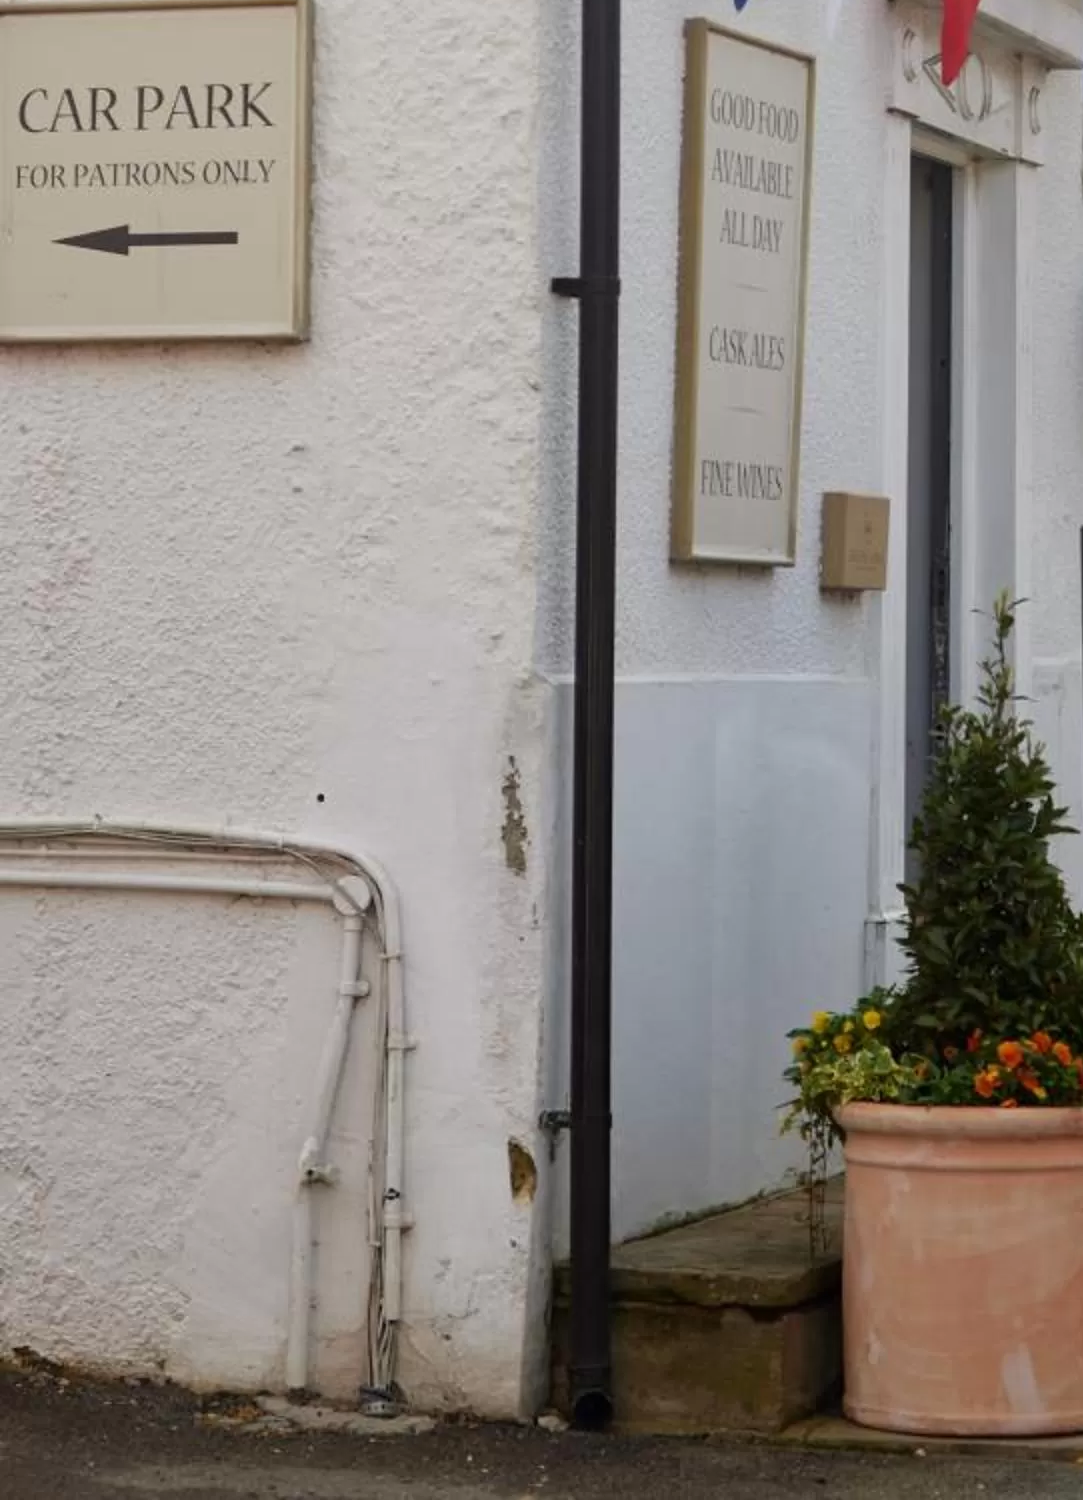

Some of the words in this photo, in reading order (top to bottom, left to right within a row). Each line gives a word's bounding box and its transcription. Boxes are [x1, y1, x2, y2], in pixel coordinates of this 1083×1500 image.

[18, 86, 121, 133] CAR
[133, 81, 277, 131] PARK
[711, 87, 755, 132] GOOD
[756, 99, 800, 143] FOOD
[15, 163, 68, 190] FOR
[73, 160, 195, 188] PATRONS
[202, 158, 276, 184] ONLY
[712, 147, 794, 199] AVAILABLE
[719, 206, 749, 248] ALL
[751, 214, 784, 254] DAY
